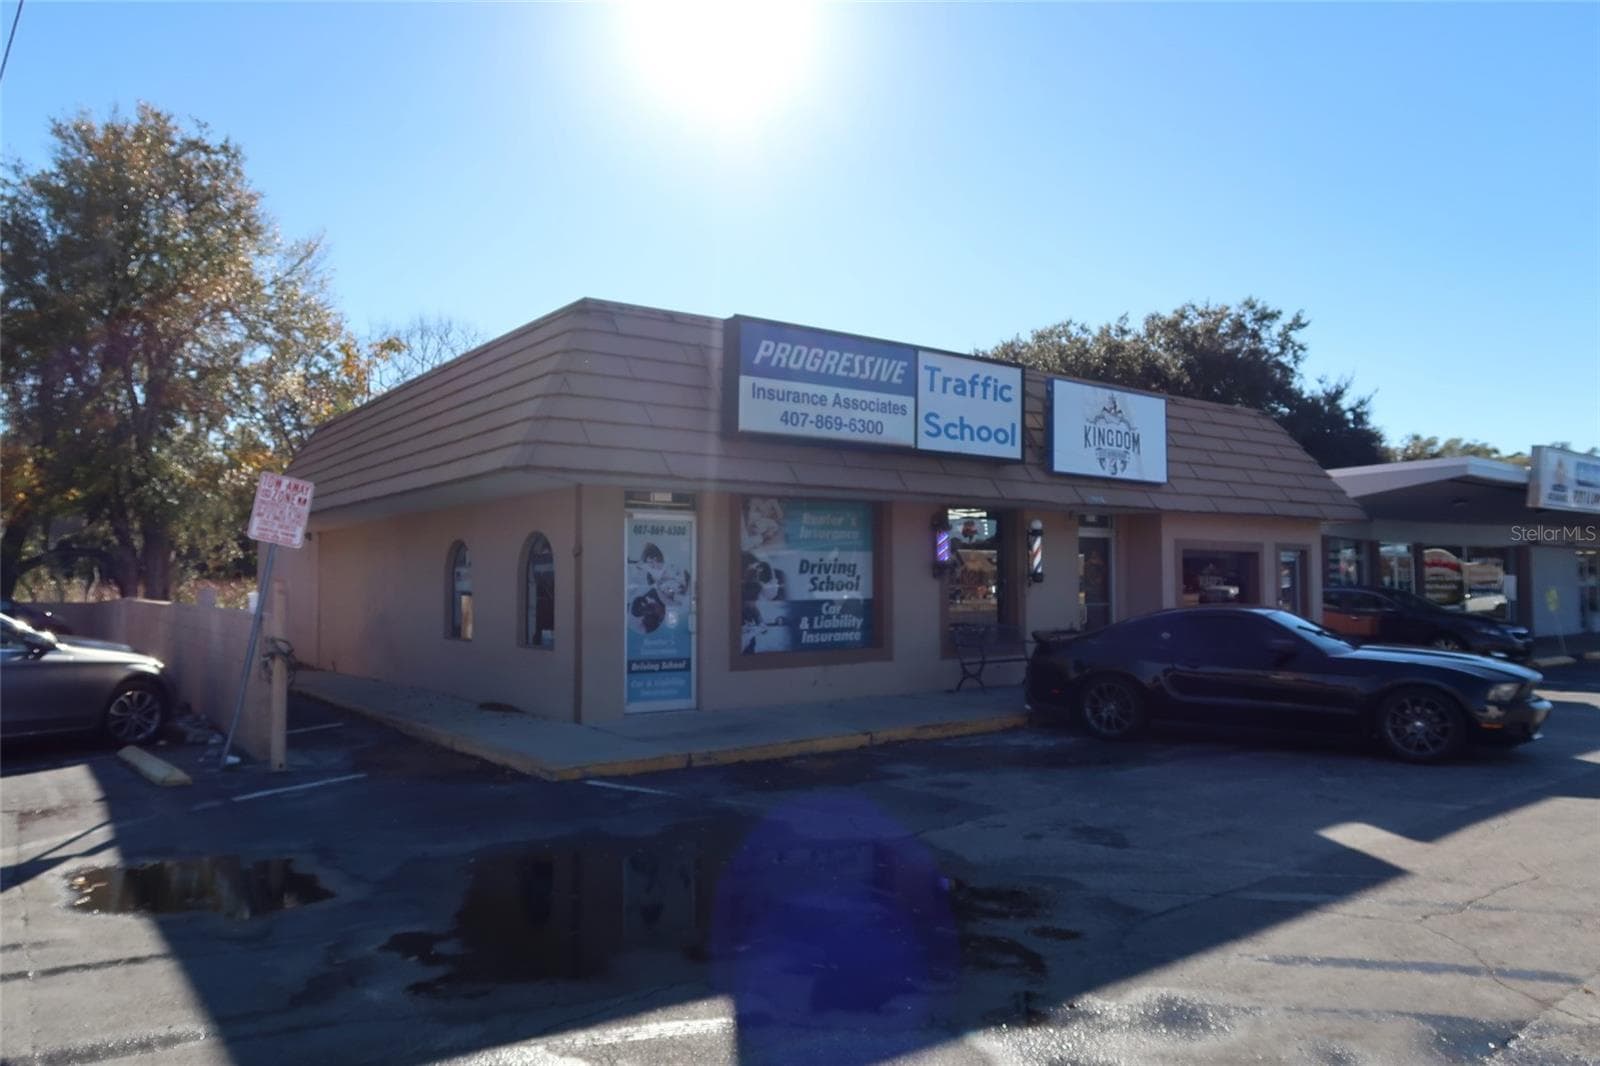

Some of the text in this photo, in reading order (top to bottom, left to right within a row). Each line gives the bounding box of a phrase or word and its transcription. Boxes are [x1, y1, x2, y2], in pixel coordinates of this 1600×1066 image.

[753, 340, 908, 385] PROGRESSIVE
[924, 365, 1013, 403] Traffic
[751, 381, 908, 417] Insurance Associates
[779, 410, 884, 436] 407-869-6300
[924, 412, 1016, 448] School
[1084, 425, 1141, 456] KINGDOM
[799, 557, 857, 577] Driving
[808, 575, 860, 592] School
[821, 602, 843, 615] Car
[800, 614, 863, 630] & Liability
[801, 630, 862, 644] Insurance
[631, 660, 687, 672] Driving School
